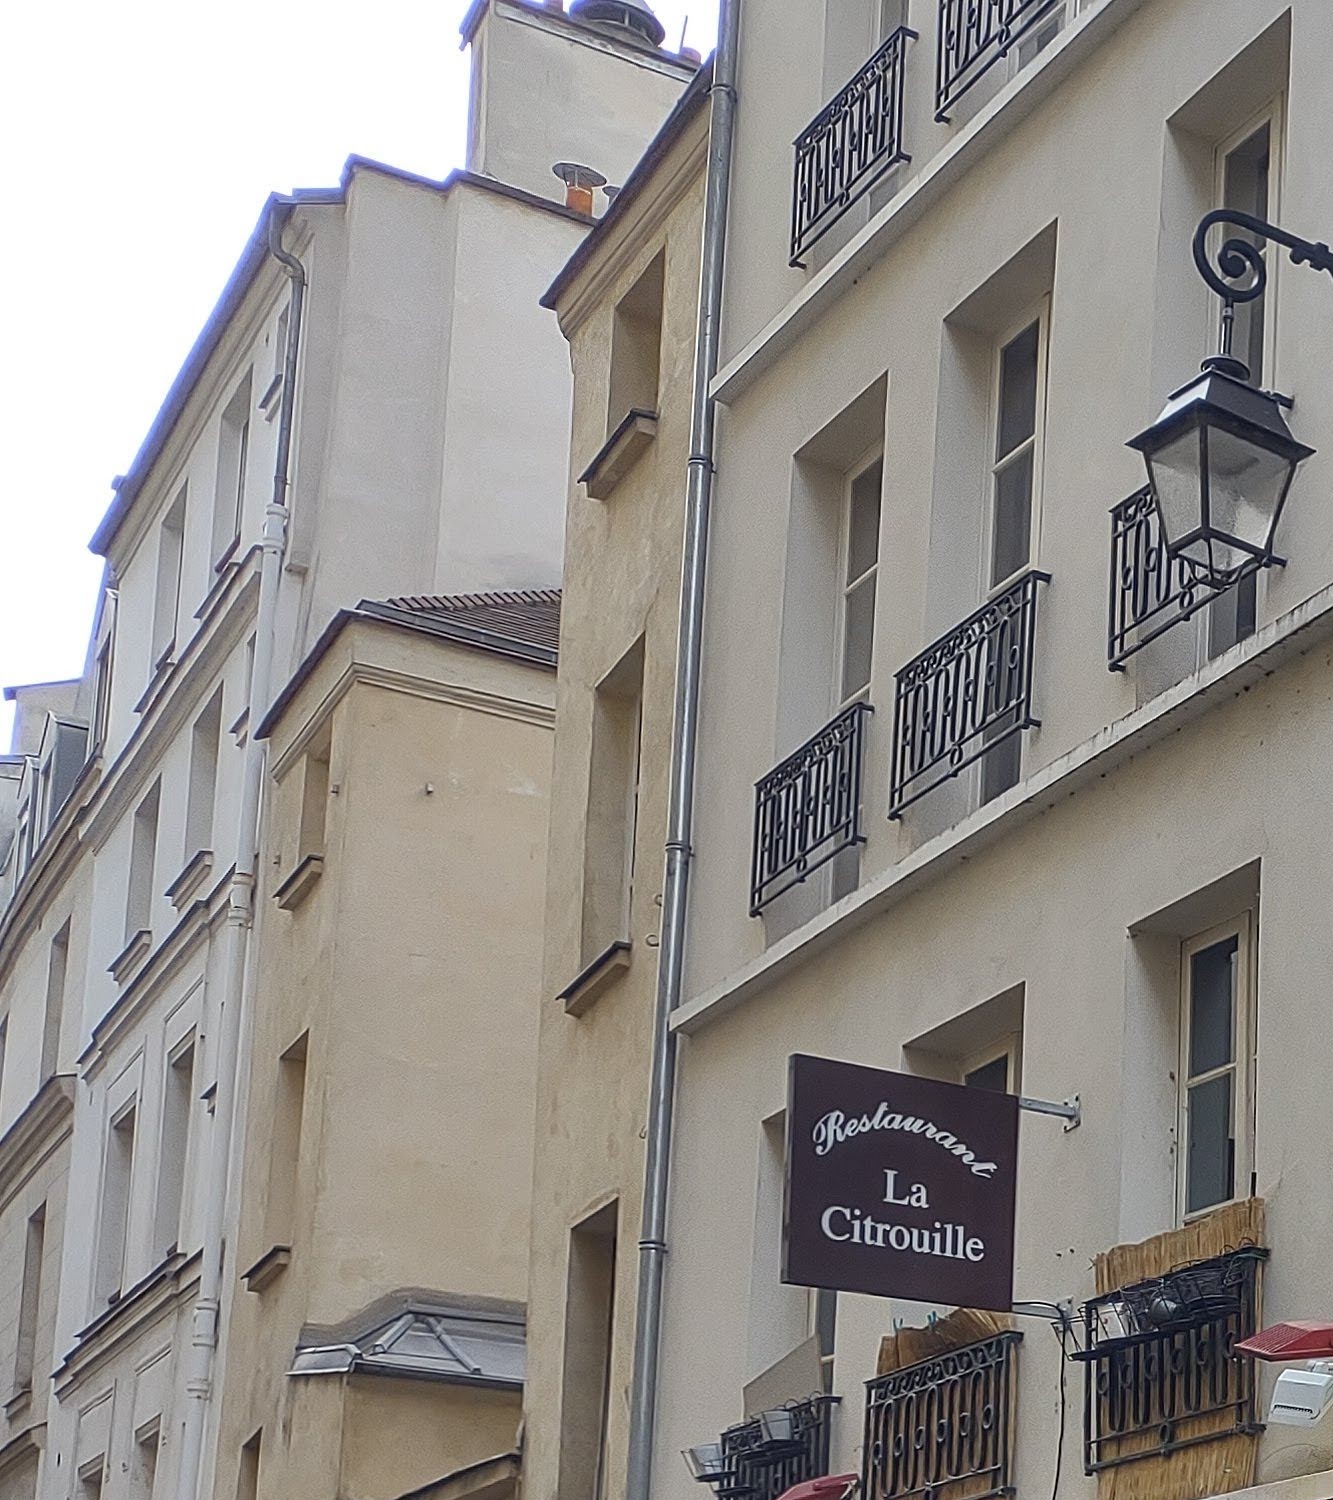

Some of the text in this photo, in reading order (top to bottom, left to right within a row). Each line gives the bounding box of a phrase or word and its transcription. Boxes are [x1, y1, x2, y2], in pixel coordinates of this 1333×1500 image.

[812, 1101, 998, 1179] Restaurant
[882, 1168, 929, 1209] La
[820, 1205, 984, 1261] Citrouille
